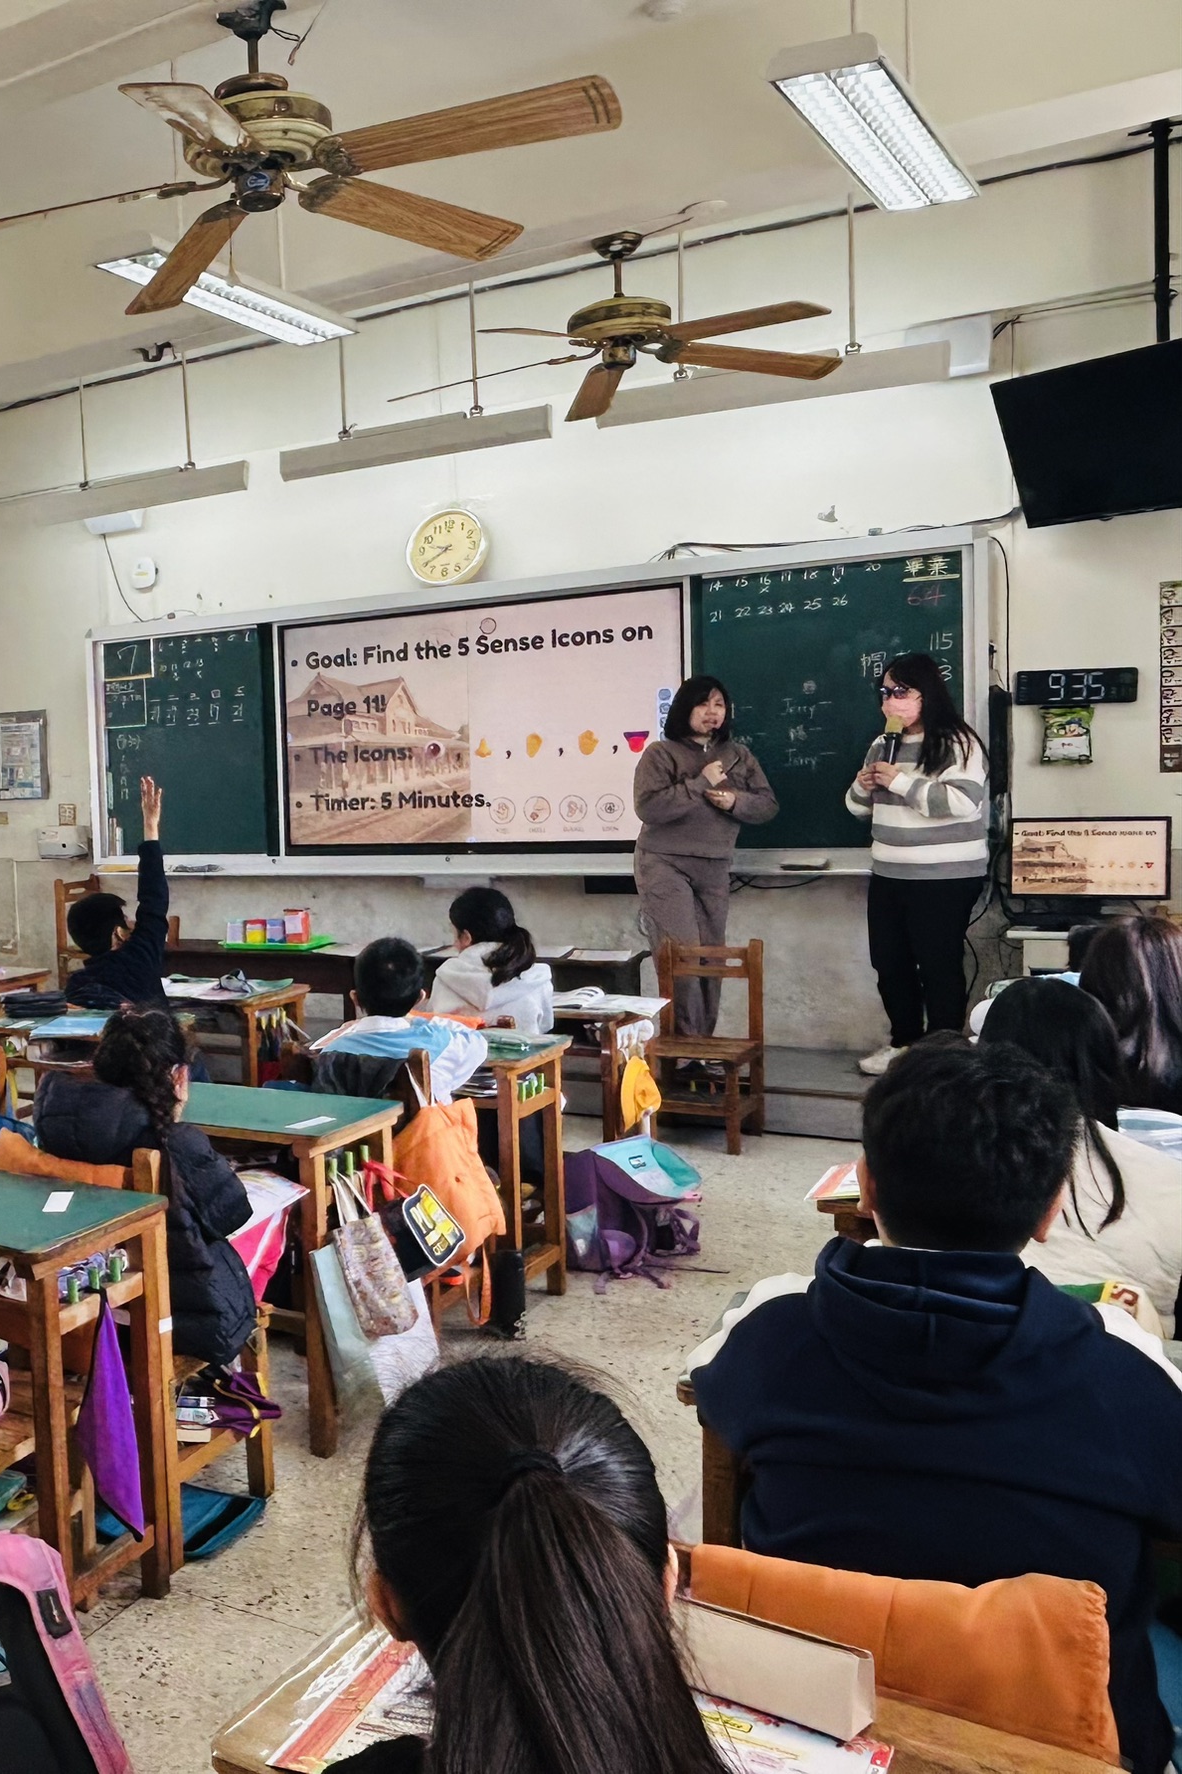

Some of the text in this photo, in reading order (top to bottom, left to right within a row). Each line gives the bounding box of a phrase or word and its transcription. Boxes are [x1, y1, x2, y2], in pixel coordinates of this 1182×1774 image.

[433, 525, 442, 534] 11
[466, 529, 474, 539] 2
[419, 546, 425, 556] 9
[454, 563, 461, 573] 5
[735, 576, 749, 587] 15
[759, 573, 771, 585] 16
[709, 609, 722, 622] 21
[735, 606, 751, 618] 22
[803, 598, 822, 610] 25
[832, 594, 848, 606] 26
[306, 625, 653, 670] Goal: Find the 5 Sense Icons on
[929, 631, 953, 651] 115
[307, 694, 387, 720] Page 11!
[312, 745, 413, 765] The Icons:
[309, 790, 492, 812] Timer: 5 Minutes.
